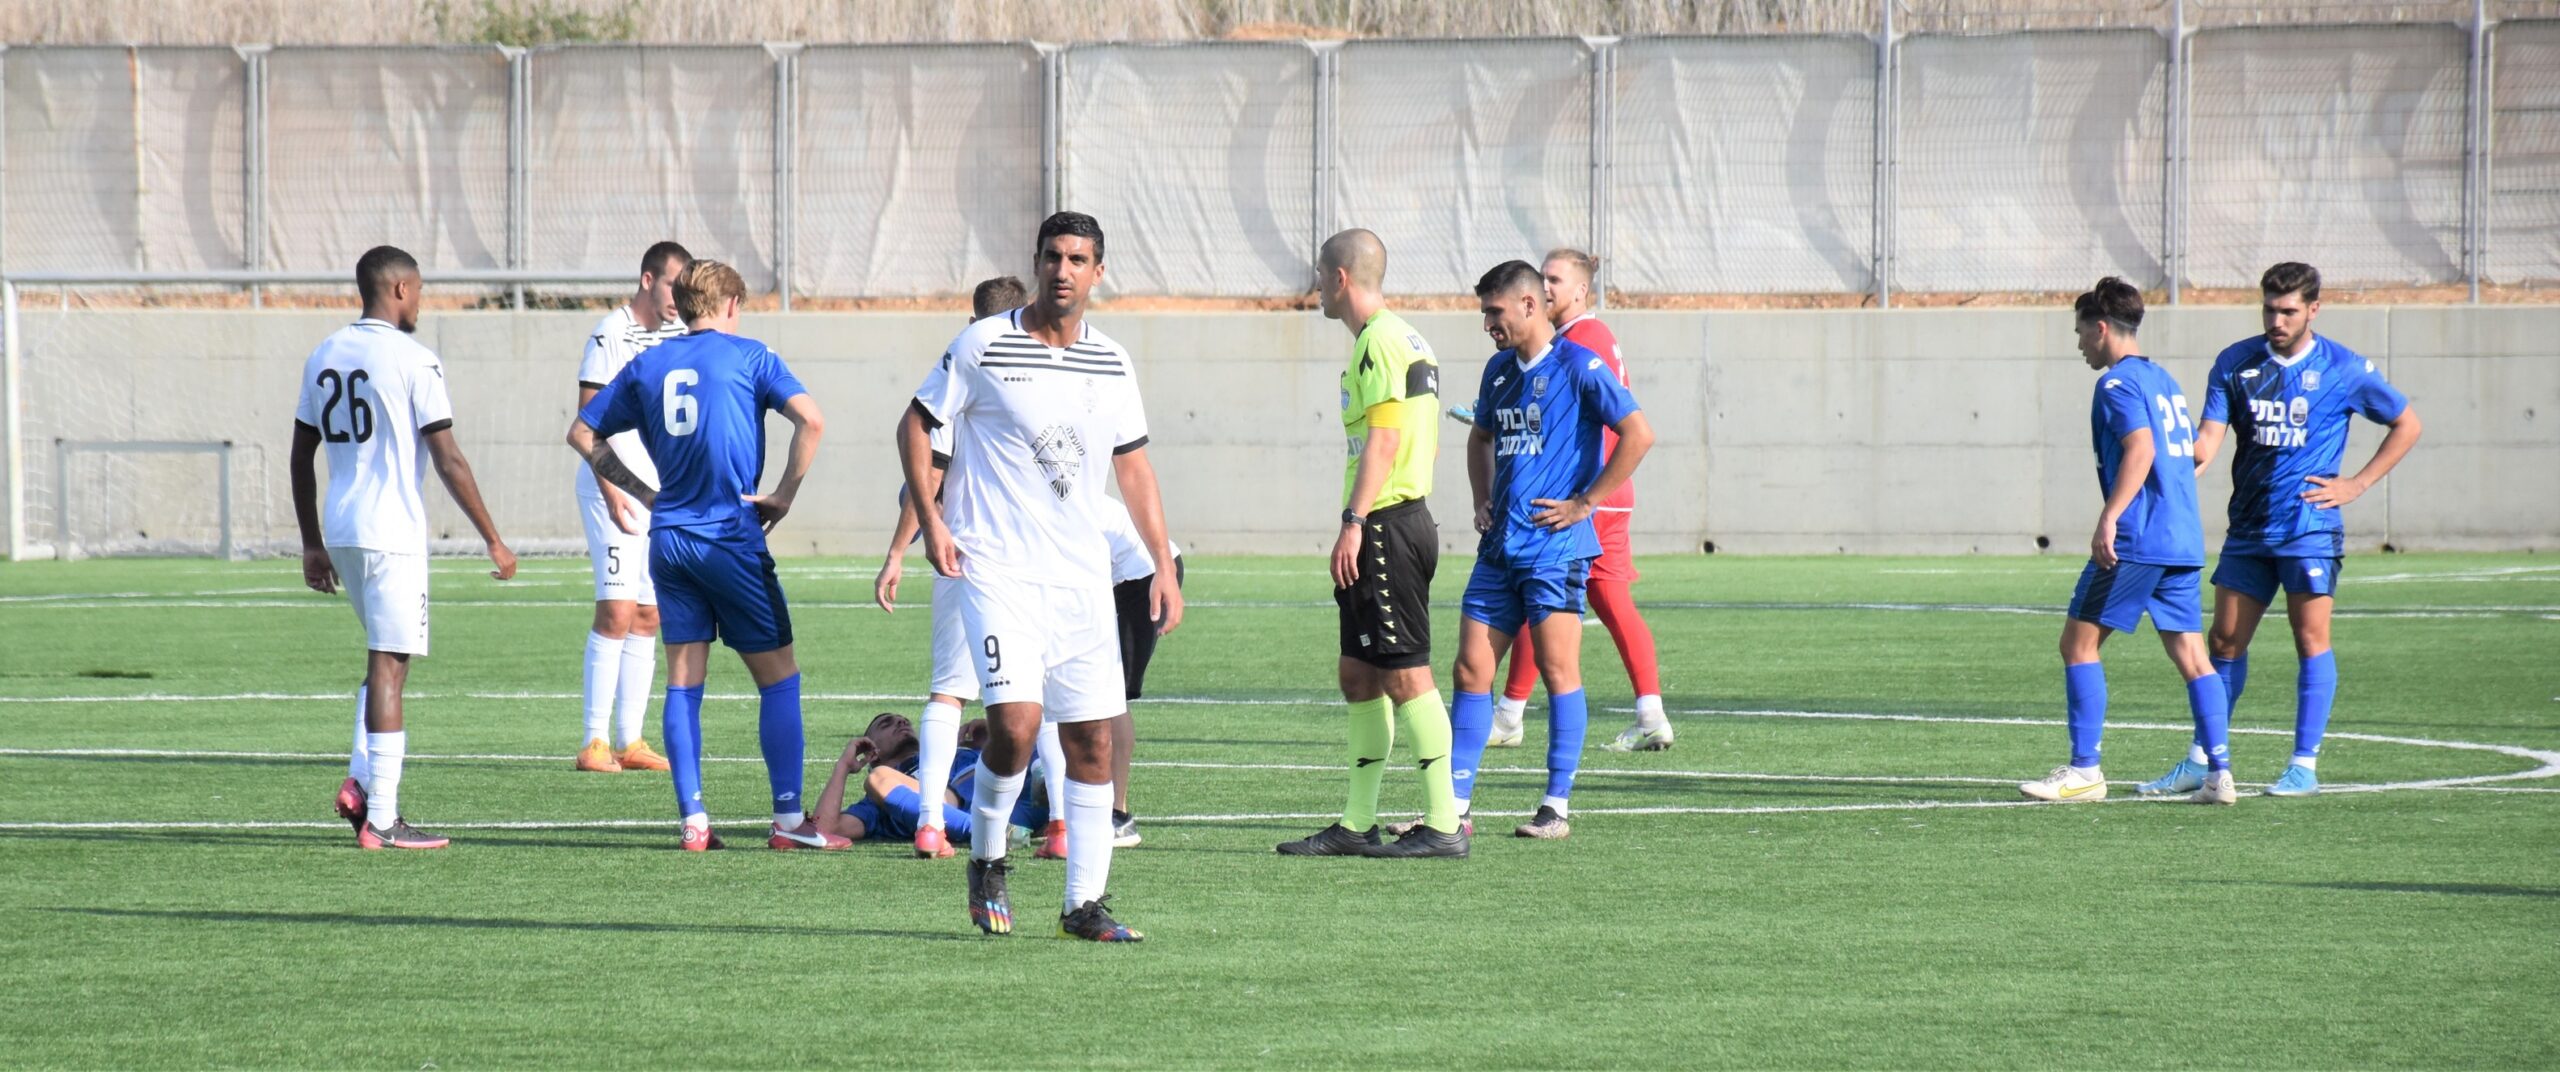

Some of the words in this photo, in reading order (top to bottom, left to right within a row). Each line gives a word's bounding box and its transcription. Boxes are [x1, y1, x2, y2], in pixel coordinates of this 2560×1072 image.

[316, 368, 373, 443] 26
[663, 368, 699, 437] 6
[1496, 407, 1527, 430] בתי
[2249, 399, 2287, 422] בתי
[2156, 394, 2195, 457] 25
[608, 546, 620, 575] 5
[984, 634, 1001, 674] 9
